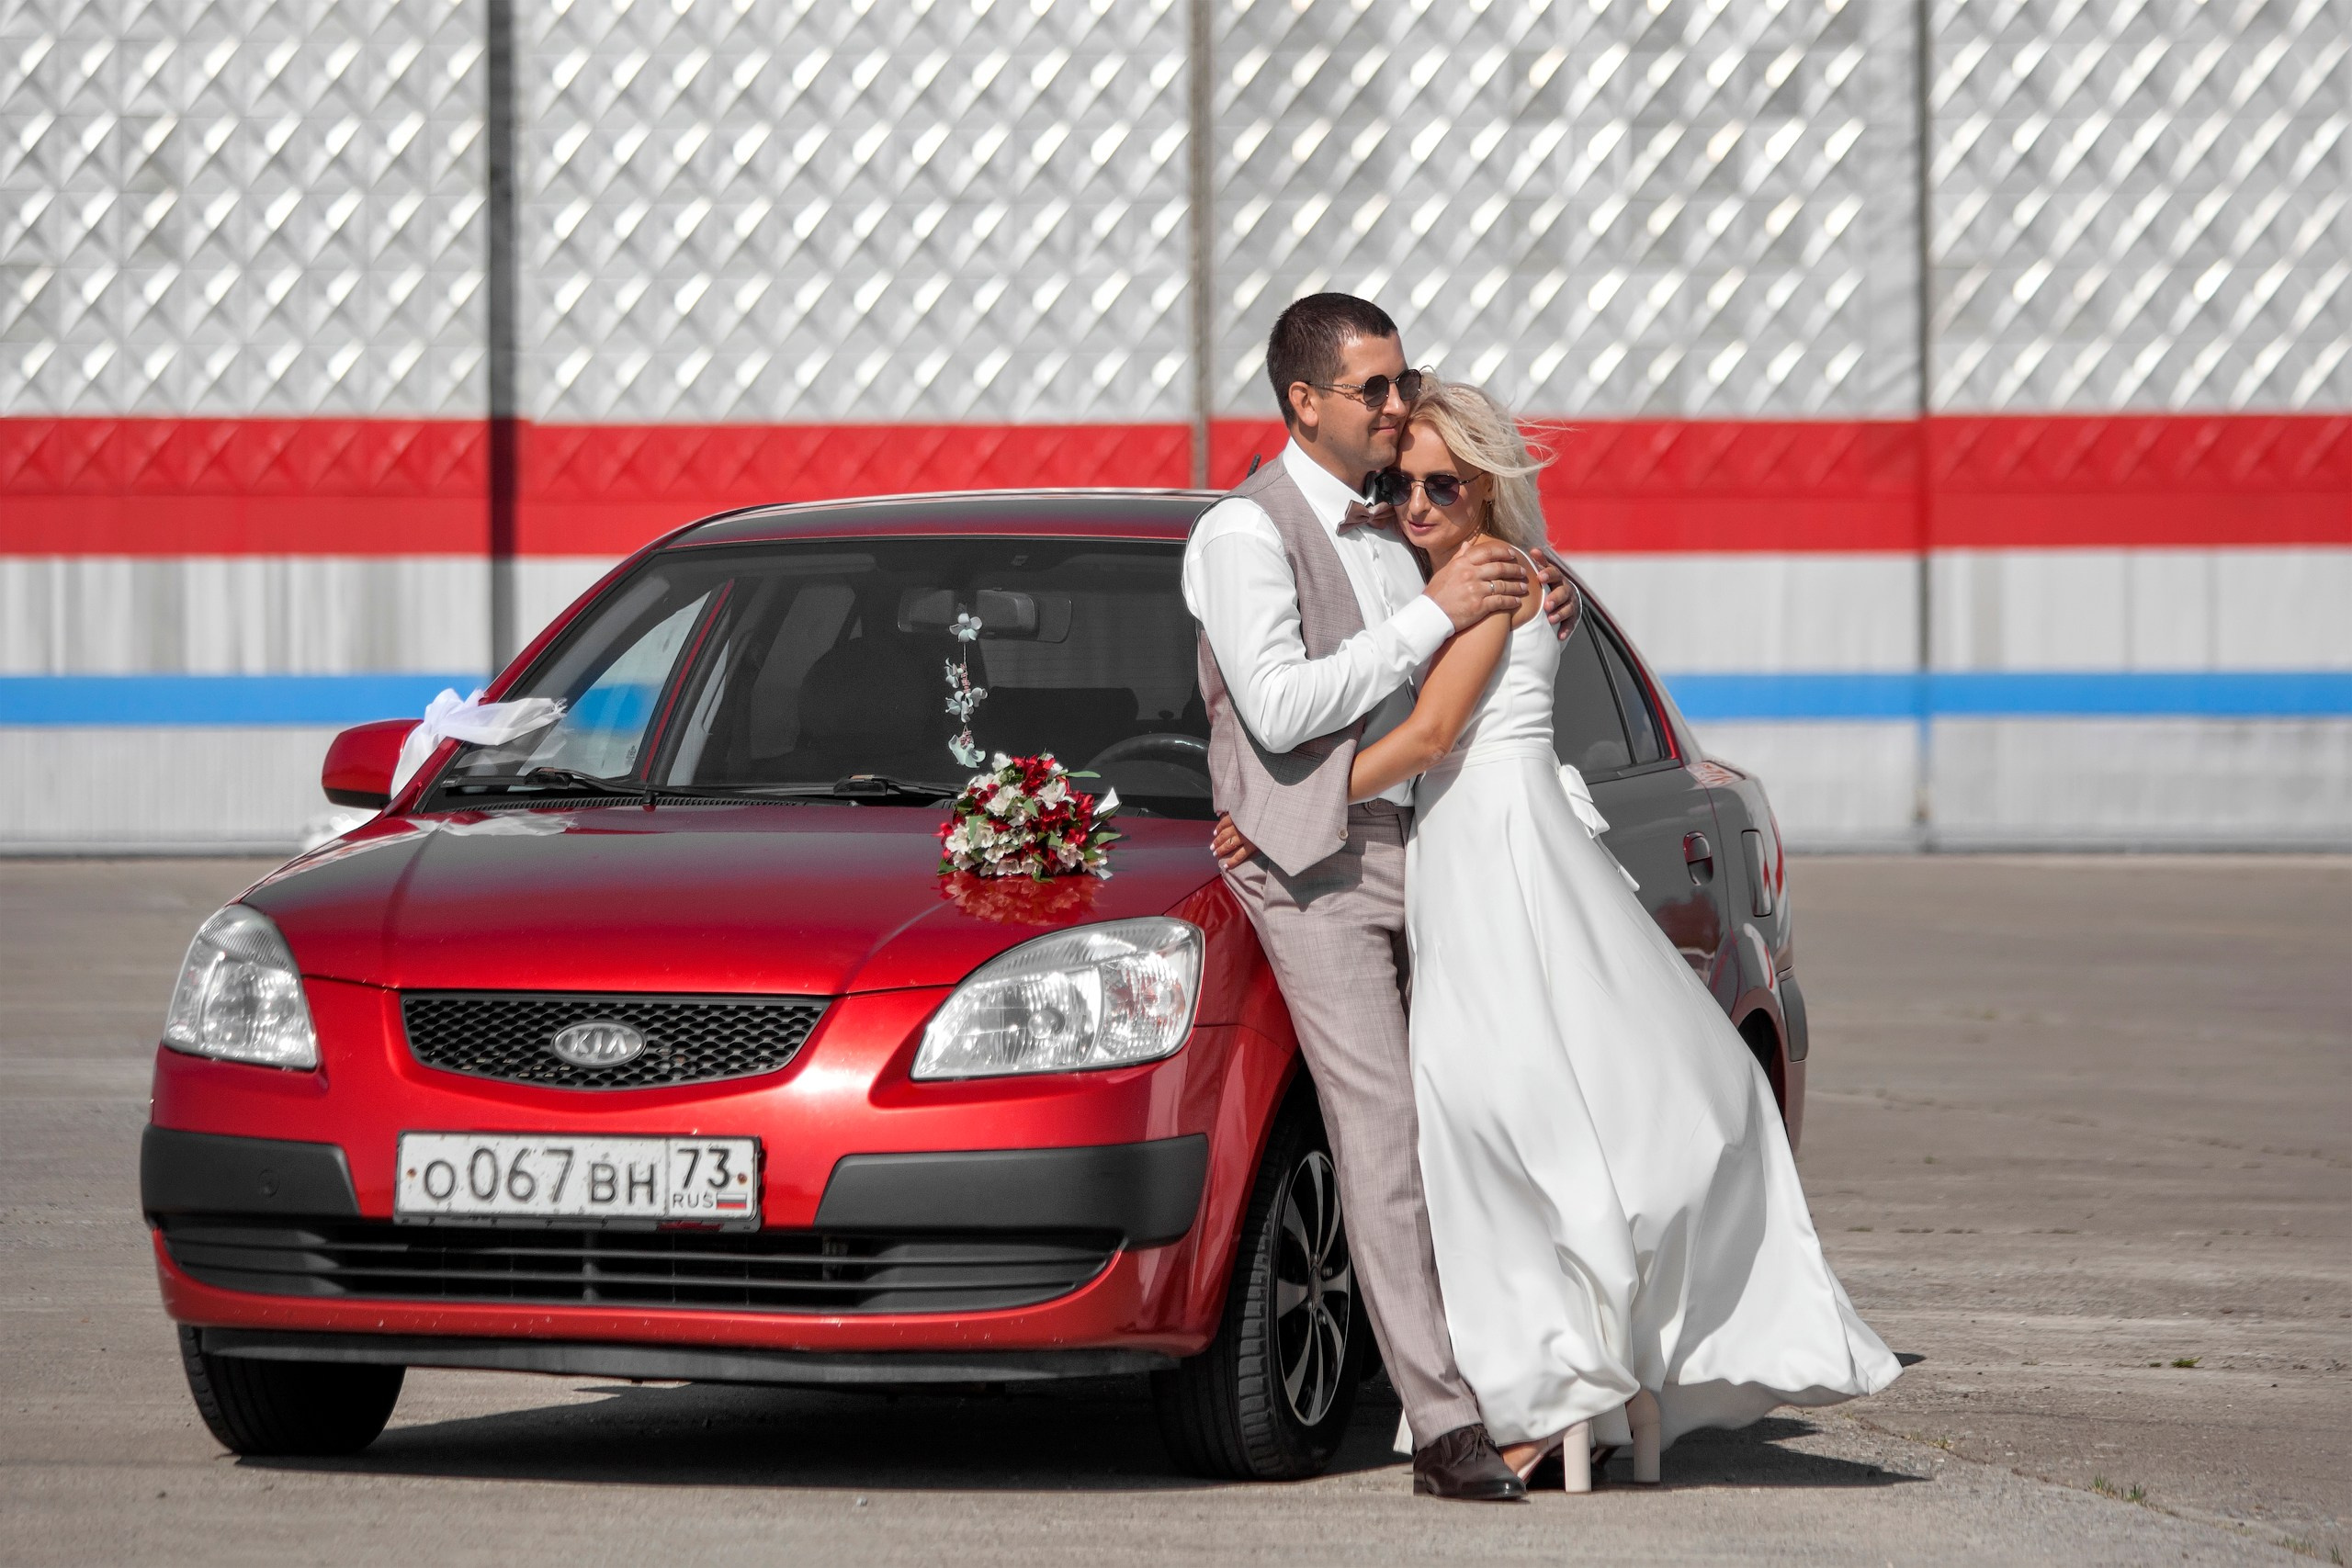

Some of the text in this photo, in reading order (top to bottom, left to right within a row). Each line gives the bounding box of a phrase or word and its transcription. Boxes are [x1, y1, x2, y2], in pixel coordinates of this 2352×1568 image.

[571, 1030, 628, 1055] KIA
[677, 1148, 729, 1190] 73
[673, 1192, 714, 1209] RUS
